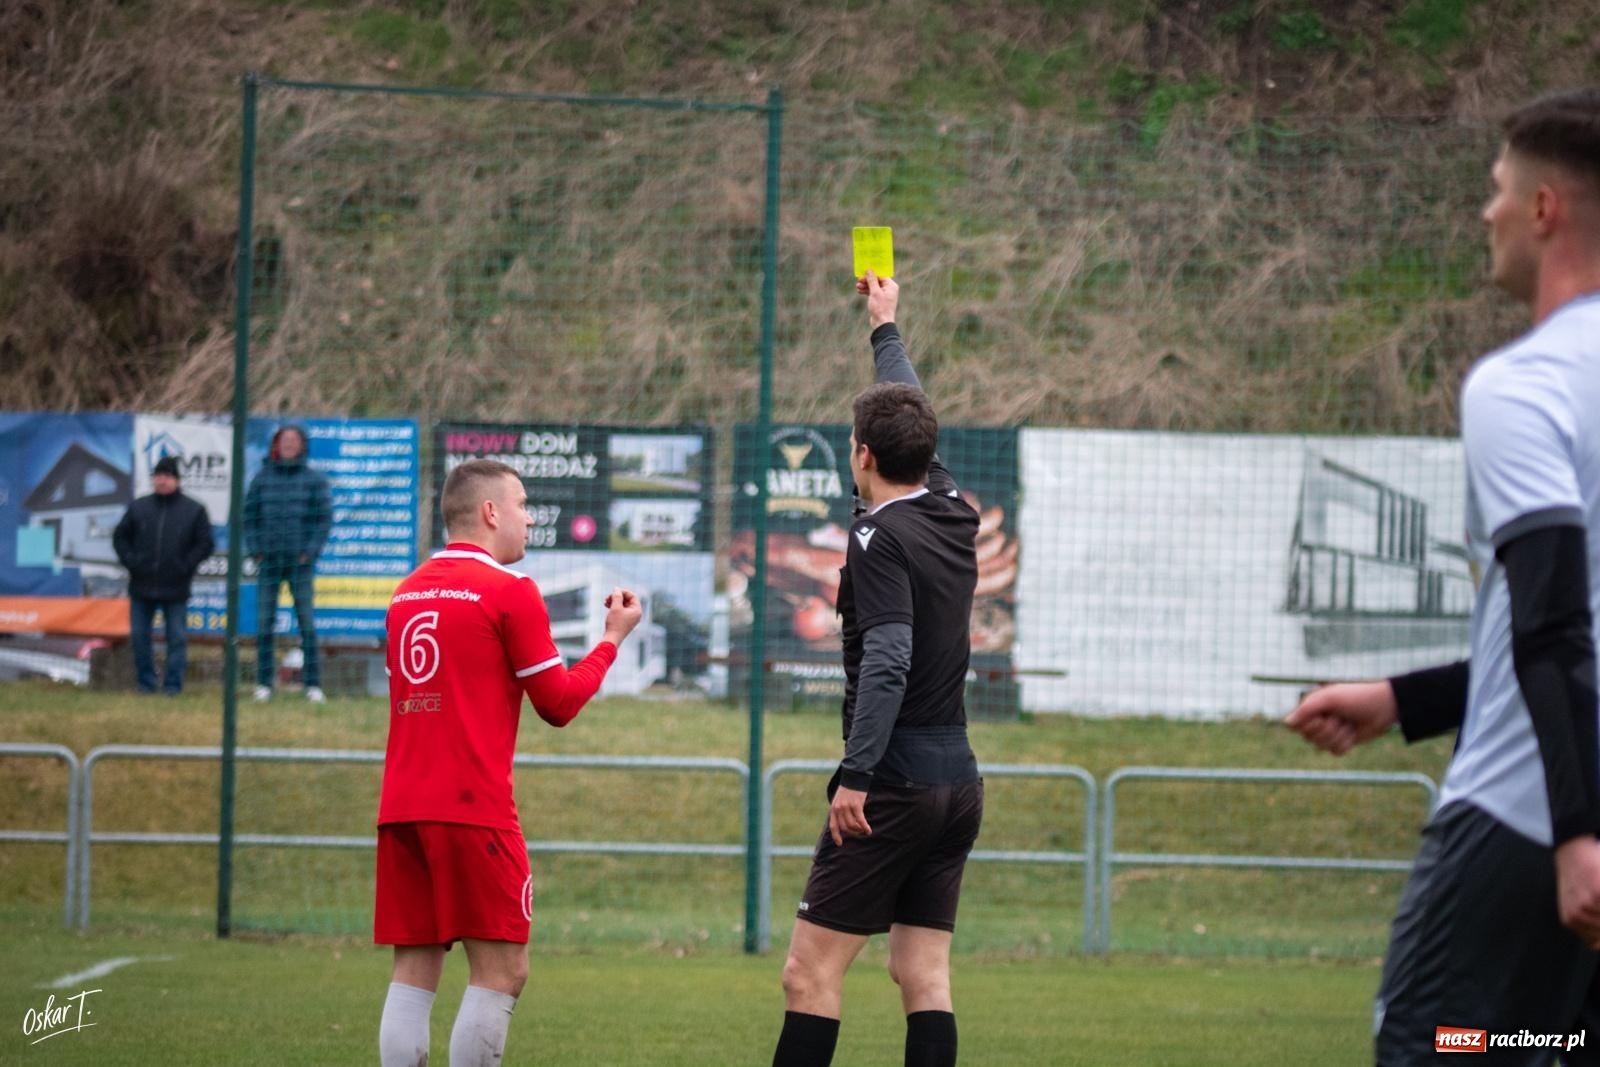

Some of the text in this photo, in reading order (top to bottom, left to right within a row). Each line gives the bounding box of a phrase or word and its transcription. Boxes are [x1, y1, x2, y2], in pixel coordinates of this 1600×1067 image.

[446, 431, 578, 454] NOWY DOM
[439, 588, 482, 603] ROGÓW
[400, 610, 440, 685] 6
